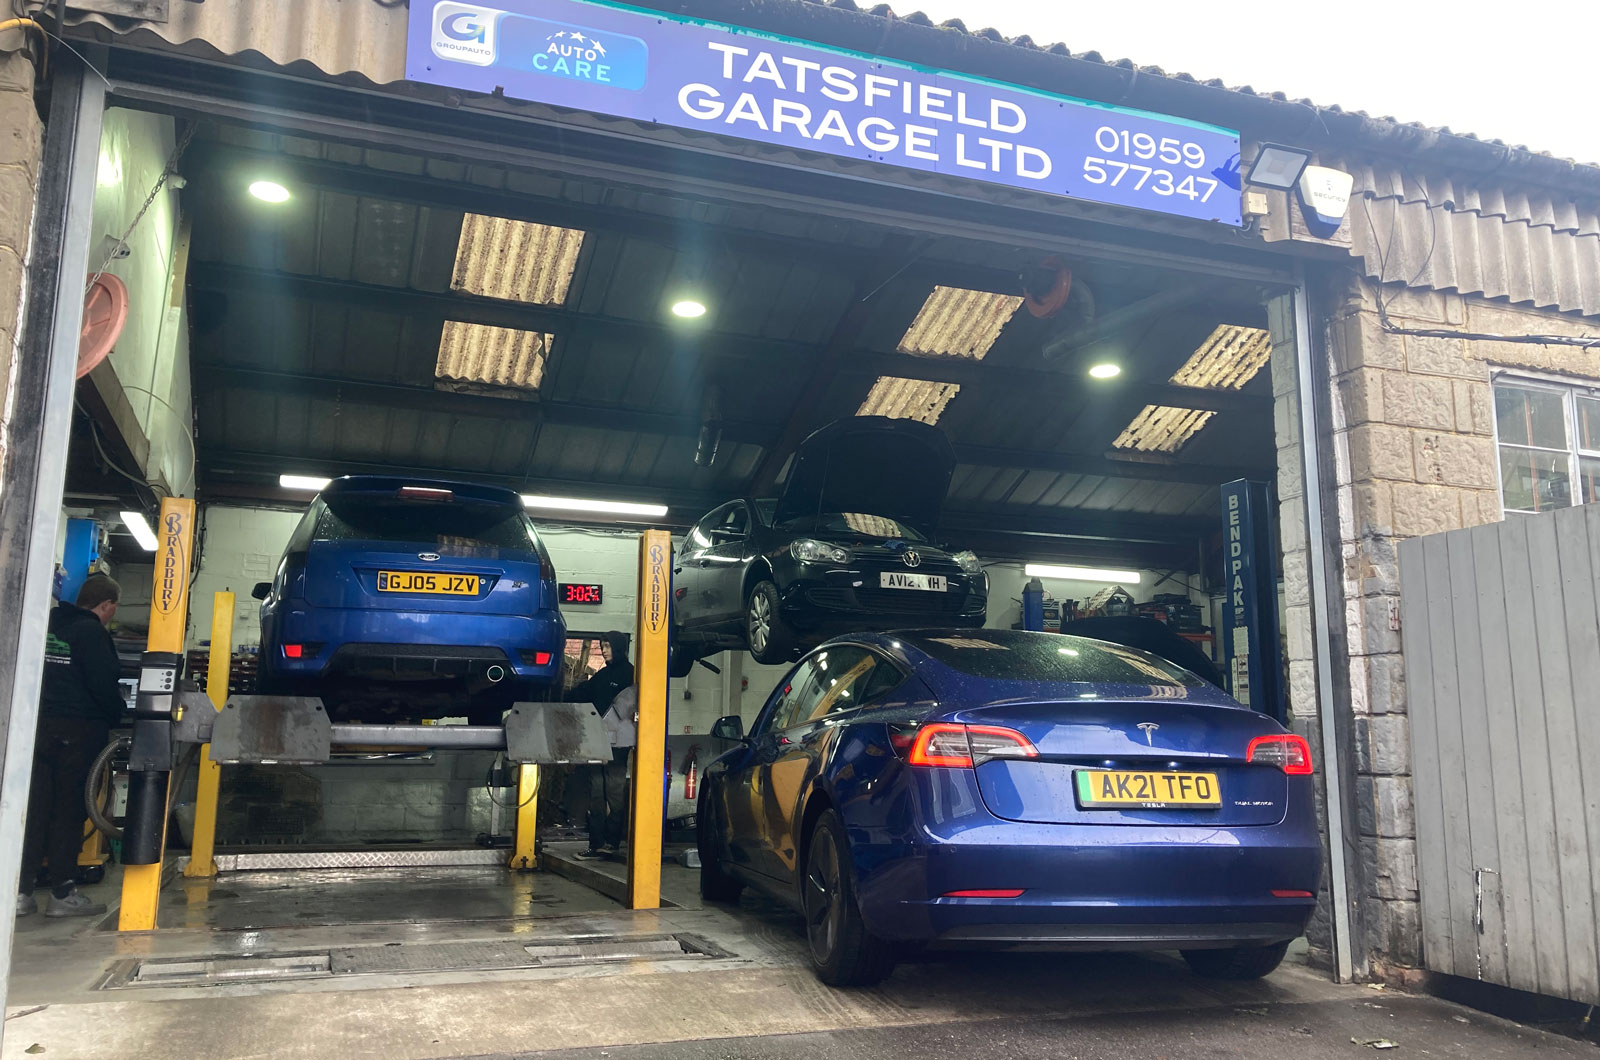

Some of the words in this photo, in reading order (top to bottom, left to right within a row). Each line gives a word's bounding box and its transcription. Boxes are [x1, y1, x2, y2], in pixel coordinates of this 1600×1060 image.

[435, 41, 492, 56] GROUPAUTO
[546, 42, 597, 62] AUTO
[532, 52, 611, 82] CARE
[708, 41, 1027, 135] TATSFIELD
[677, 82, 940, 162] GARAGE
[955, 133, 1053, 180] LTD
[1095, 126, 1206, 169] 01959
[1083, 156, 1218, 203] 577347
[162, 512, 182, 610] BRADBURY
[390, 575, 436, 590] GJ05
[442, 577, 475, 592] JZV
[566, 585, 593, 602] 3:02
[650, 544, 664, 631] BRADBURY
[888, 574, 915, 588] AV12
[1102, 773, 1156, 799] AK21
[1162, 775, 1211, 800] TFO
